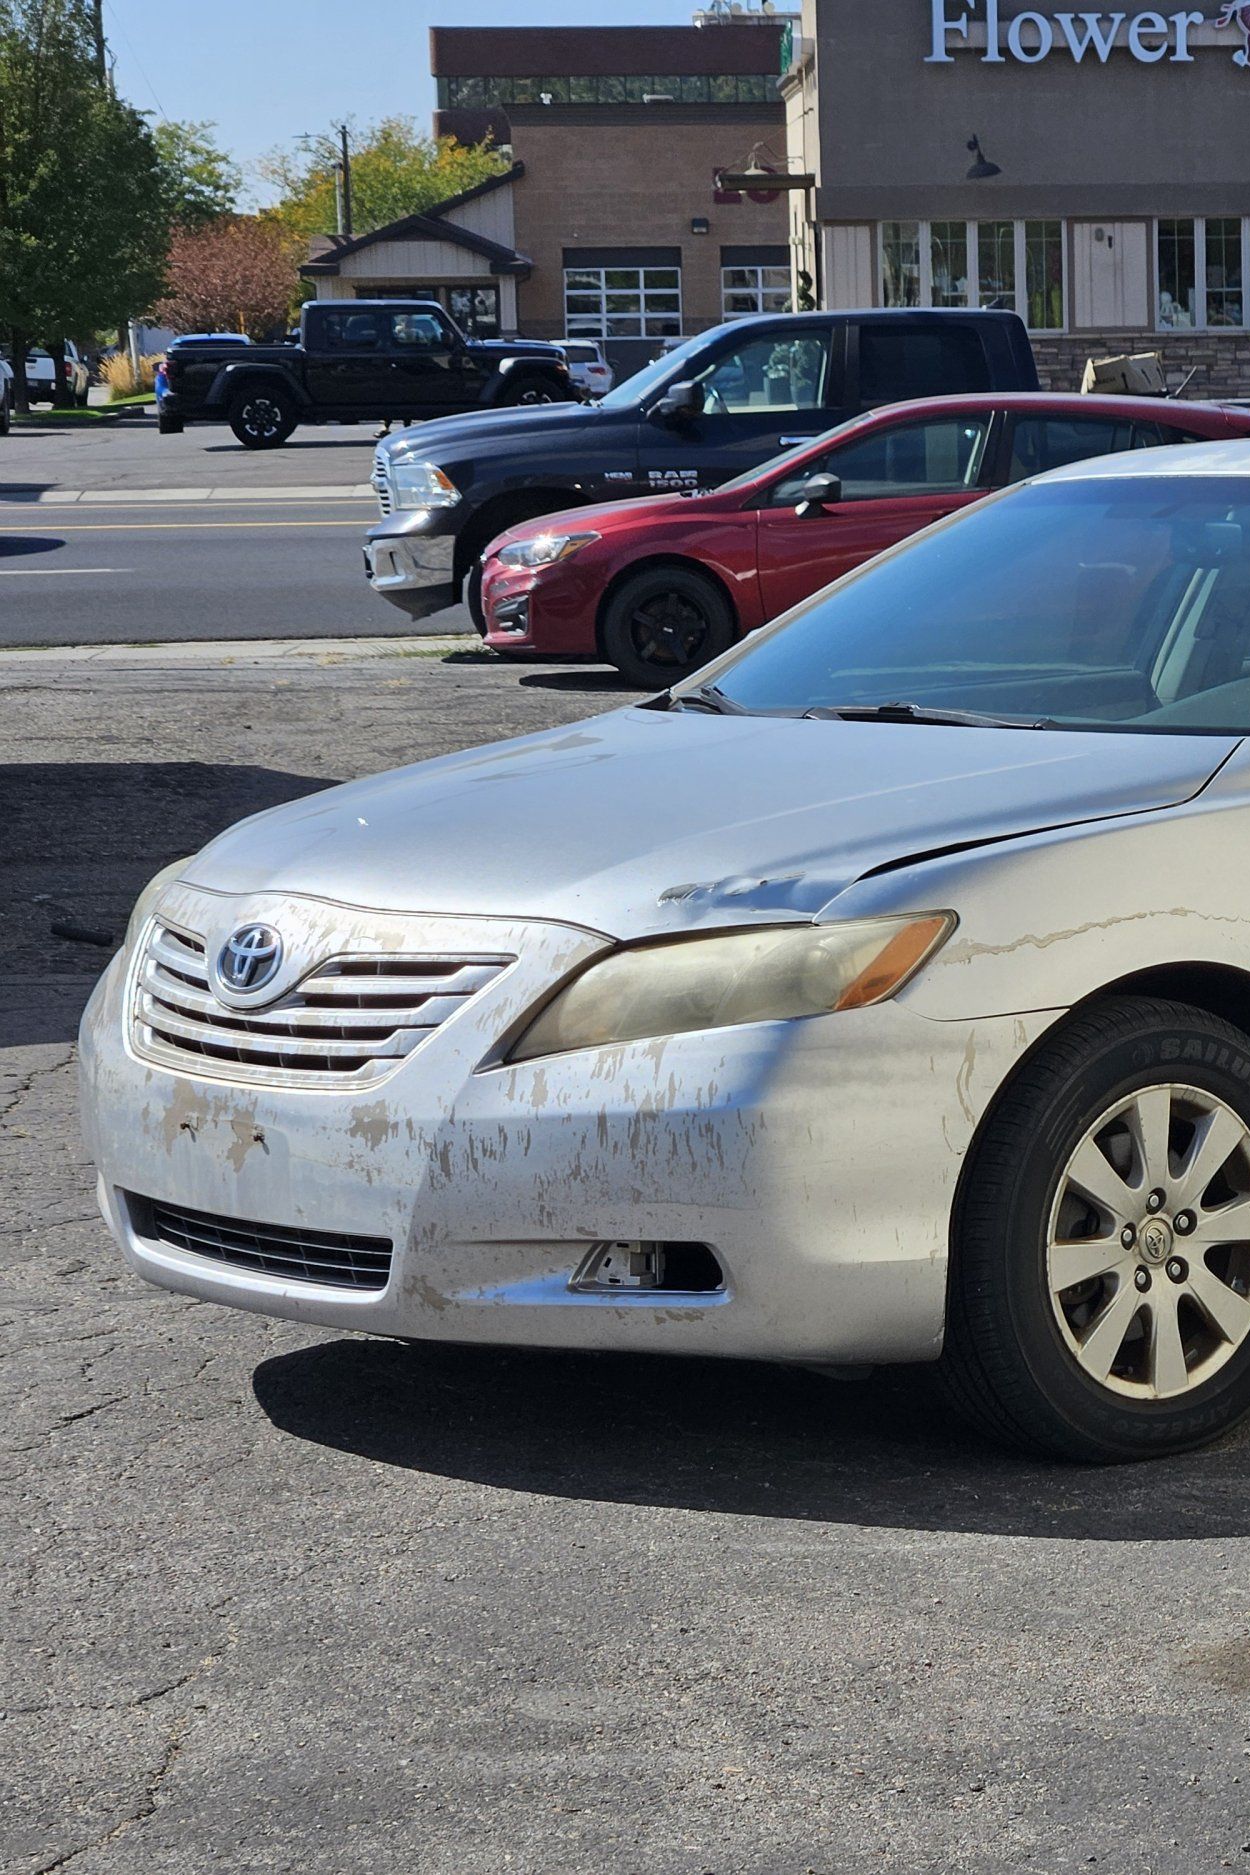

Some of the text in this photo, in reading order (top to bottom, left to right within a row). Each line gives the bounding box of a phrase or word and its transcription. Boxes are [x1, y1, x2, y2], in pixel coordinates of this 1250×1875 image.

[923, 0, 1205, 63] Flower
[647, 470, 698, 479] RAM
[648, 479, 698, 488] 1500
